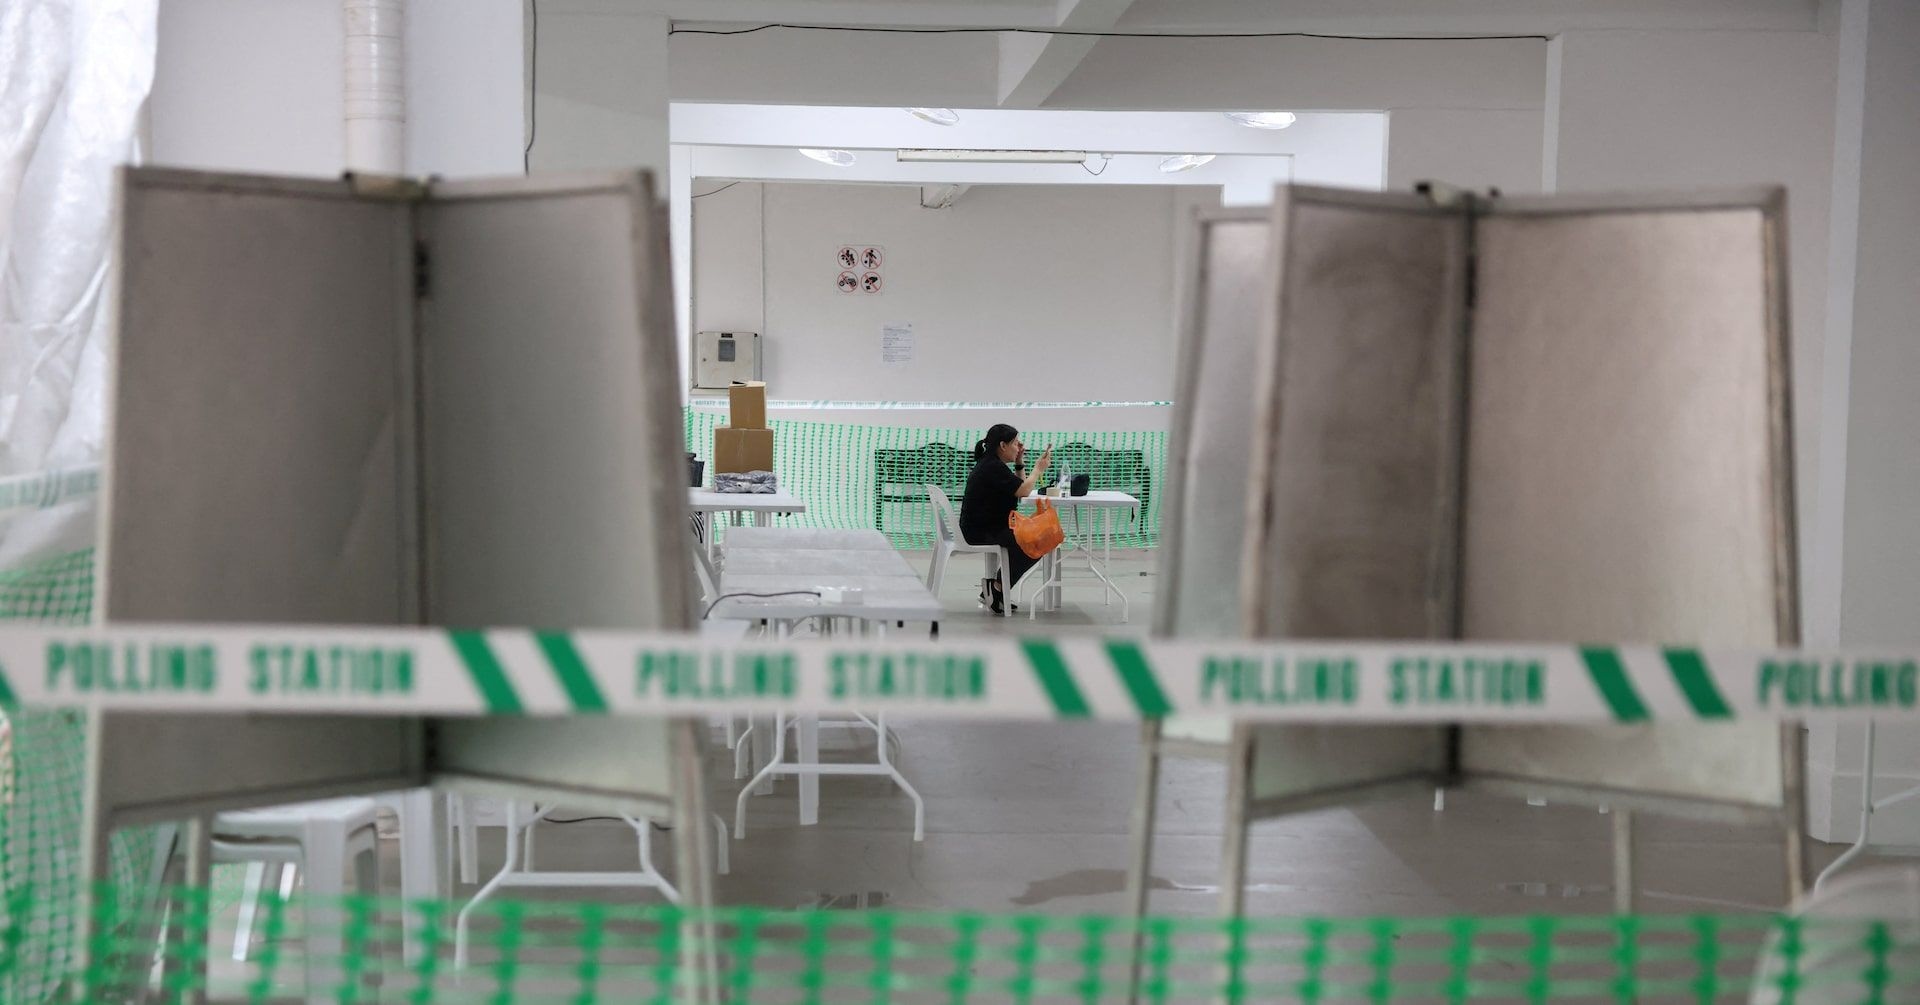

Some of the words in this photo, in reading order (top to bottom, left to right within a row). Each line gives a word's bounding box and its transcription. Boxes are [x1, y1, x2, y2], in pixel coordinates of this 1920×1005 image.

[46, 644, 217, 692] POLLING
[249, 646, 415, 695] STATION
[636, 650, 798, 698] POLLING
[828, 653, 986, 699] STATION
[1201, 656, 1358, 704] POLLING
[1388, 658, 1544, 704] STATION
